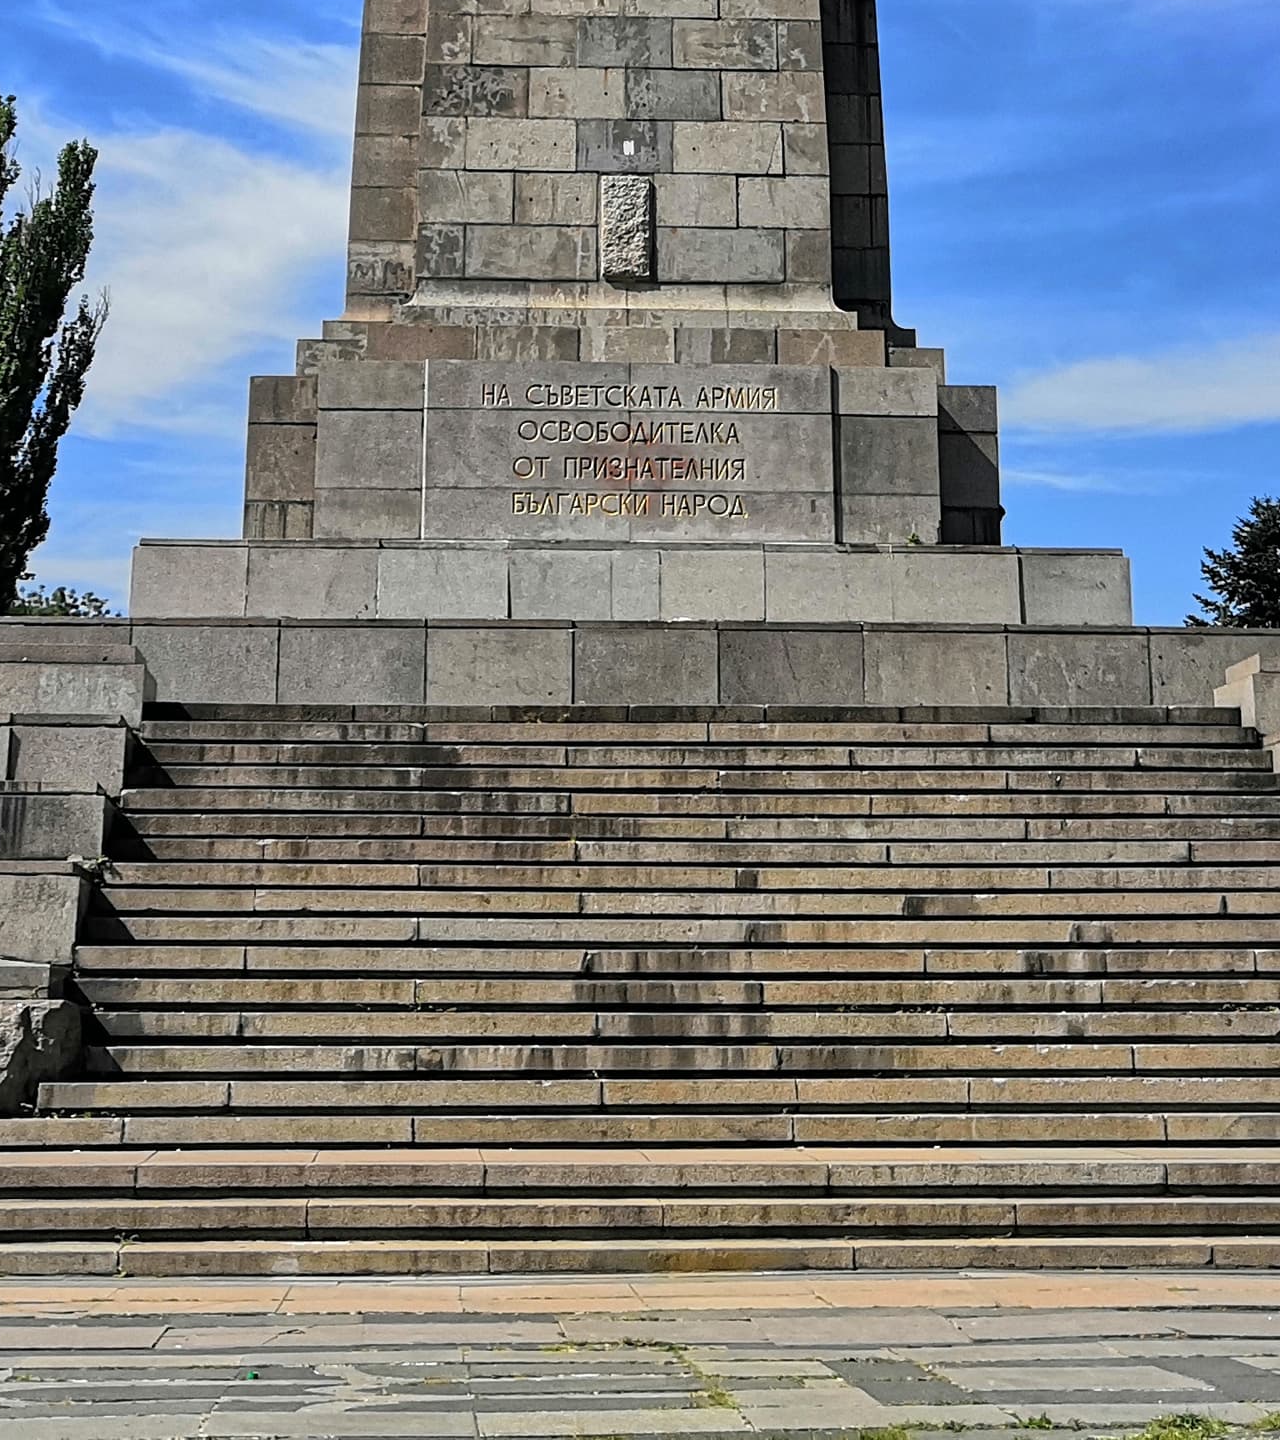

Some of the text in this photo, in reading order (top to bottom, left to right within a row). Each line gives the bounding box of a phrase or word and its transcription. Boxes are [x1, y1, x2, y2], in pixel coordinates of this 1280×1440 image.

[482, 384, 778, 410] НА СЪВЕТСКАТА АРМИЯ
[518, 420, 740, 445] ОСВОБОДИТЕЛКА
[513, 456, 746, 481] ОТ ПРИЗНАТЕЛНИЯ
[512, 492, 649, 516] БЪЛГАРСКИ
